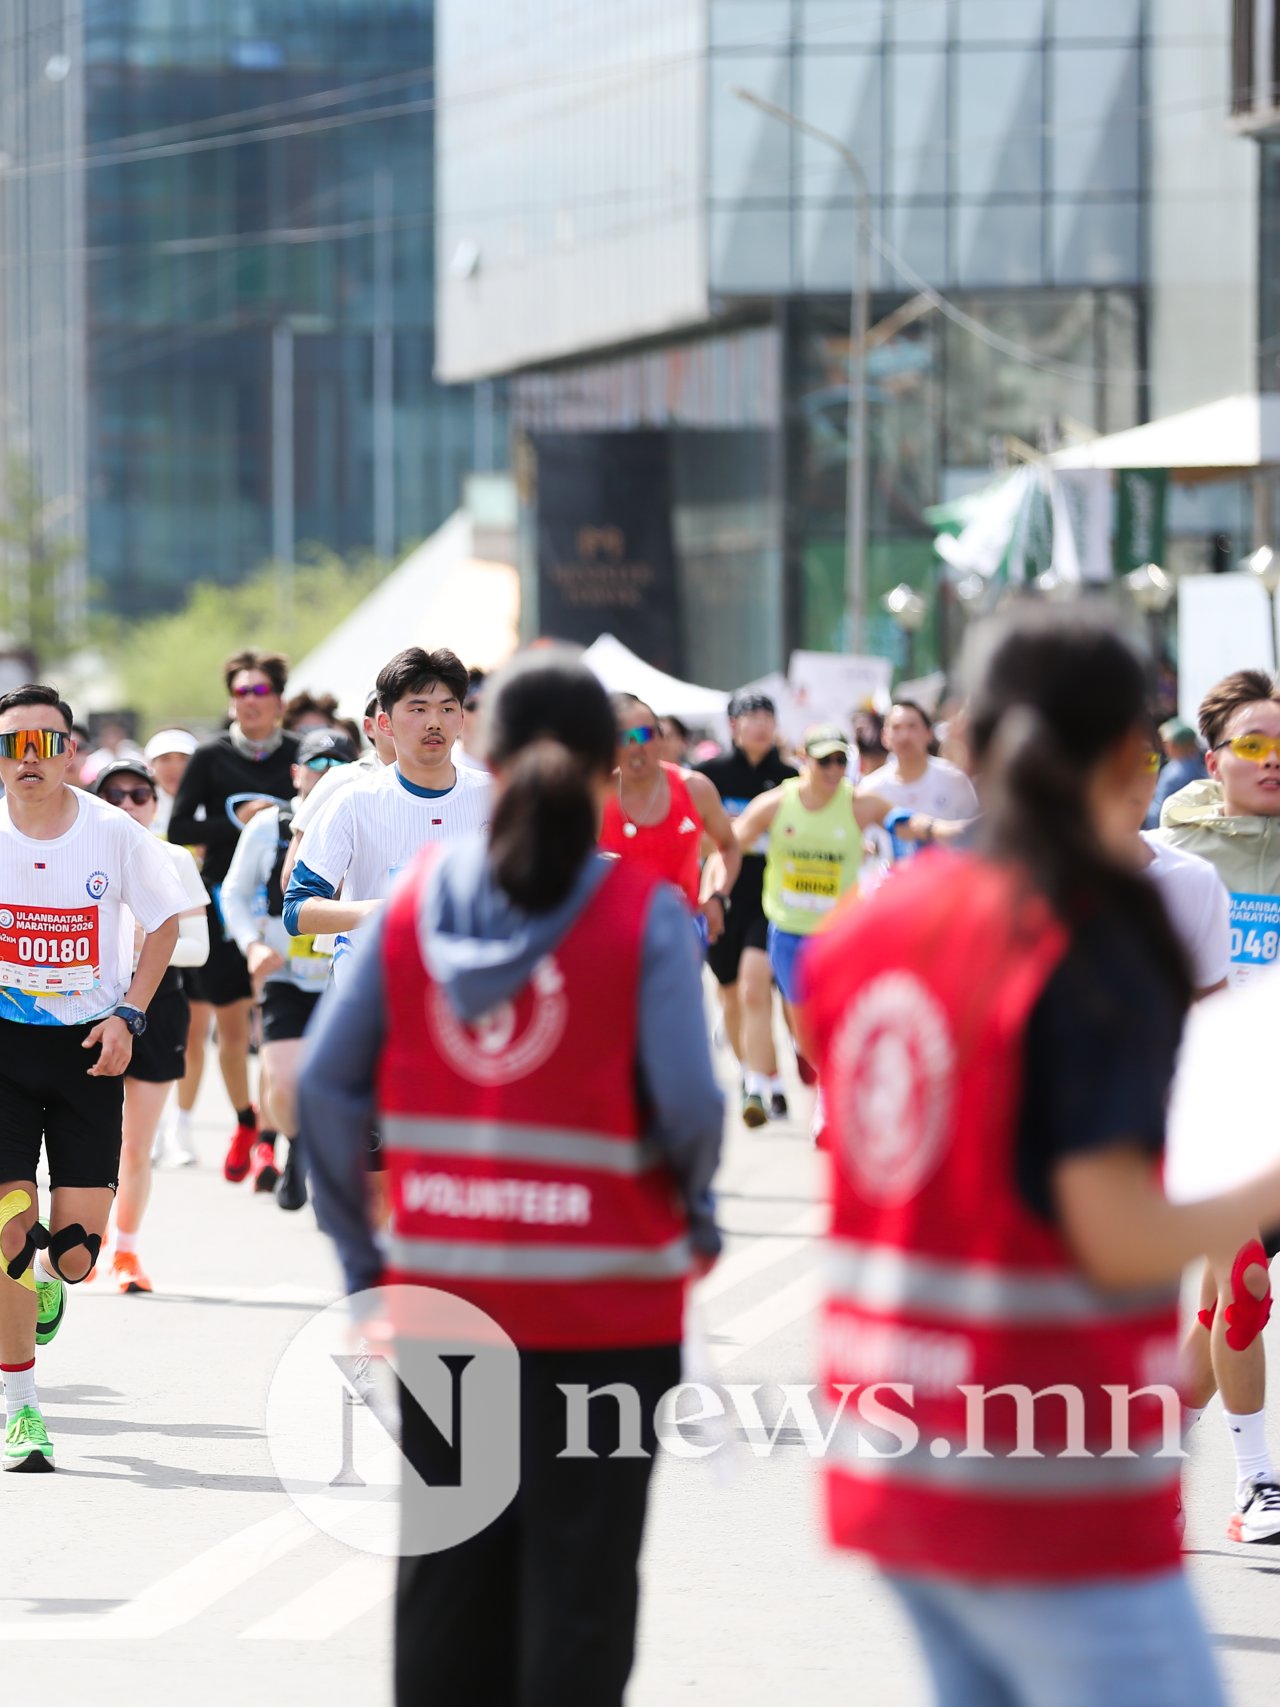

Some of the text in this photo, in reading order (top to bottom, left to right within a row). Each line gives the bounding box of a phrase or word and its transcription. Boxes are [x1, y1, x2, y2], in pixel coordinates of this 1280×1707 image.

[1229, 900, 1280, 912] LAANBA
[16, 911, 84, 924] ULAANBAATAR
[16, 920, 94, 932] MARATHON 2026
[18, 936, 90, 962] 00180
[1229, 927, 1280, 961] 048
[402, 1170, 592, 1227] VOLUNTEER
